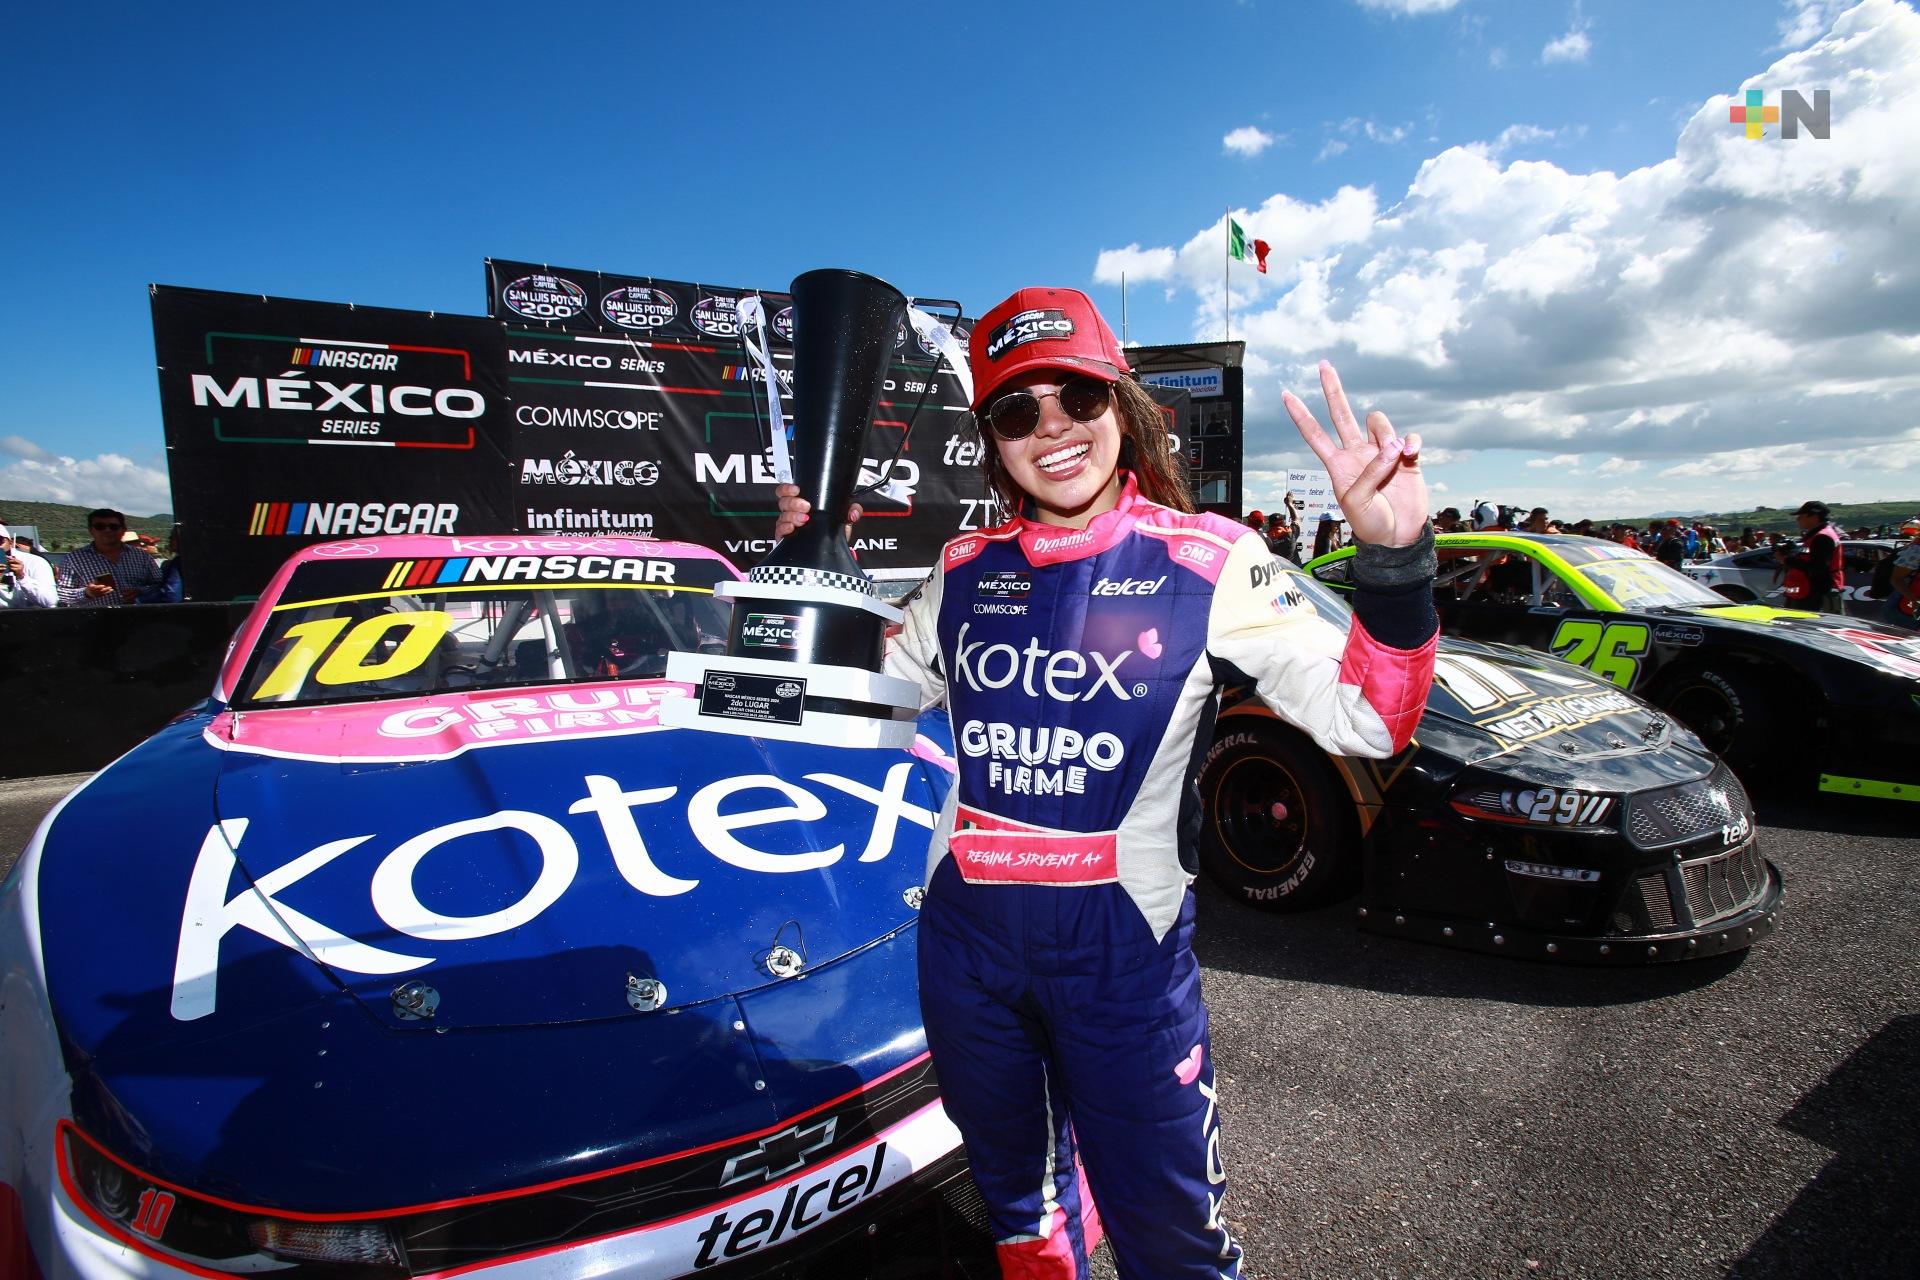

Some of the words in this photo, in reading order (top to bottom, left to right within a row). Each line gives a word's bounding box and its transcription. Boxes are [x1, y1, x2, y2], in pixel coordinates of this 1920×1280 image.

[509, 290, 528, 300] SAN
[529, 293, 549, 302] LUIS
[521, 303, 573, 318] 200
[606, 300, 621, 311] SAN
[621, 302, 643, 313] LUIS
[643, 304, 674, 316] POTOSÍ
[695, 310, 711, 320] SAN
[712, 311, 729, 321] LUIS
[616, 312, 665, 326] 200
[319, 350, 398, 371] NASCAR
[508, 349, 612, 369] MÉXICO
[620, 358, 666, 374] SERIES
[191, 371, 486, 418] MÉXICO
[321, 419, 381, 435] SERIES
[304, 502, 460, 536] NASCAR
[527, 508, 653, 529] infinitum
[853, 538, 898, 551] ANE
[949, 543, 977, 557] OMP
[1033, 530, 1094, 553] Dynamic
[1179, 544, 1216, 564] OMP
[463, 556, 676, 584] NASCAR
[978, 580, 1031, 590] MÉXICO
[1091, 576, 1168, 596] telcel
[973, 603, 1028, 615] COMMSCOPE
[252, 611, 454, 701] 10
[730, 699, 744, 707] 2do
[744, 700, 770, 710] LUGAR
[1702, 671, 1744, 725] GENERAL
[377, 686, 688, 738] GRUP
[468, 706, 662, 739] FIRM
[961, 719, 1125, 772] GRUPO
[989, 762, 1088, 796] FIRME
[966, 849, 1013, 867] REGINA
[1242, 850, 1317, 900] GENERAL
[171, 763, 938, 1022] kotex
[130, 1187, 176, 1240] 10
[694, 1141, 887, 1270] telcel
